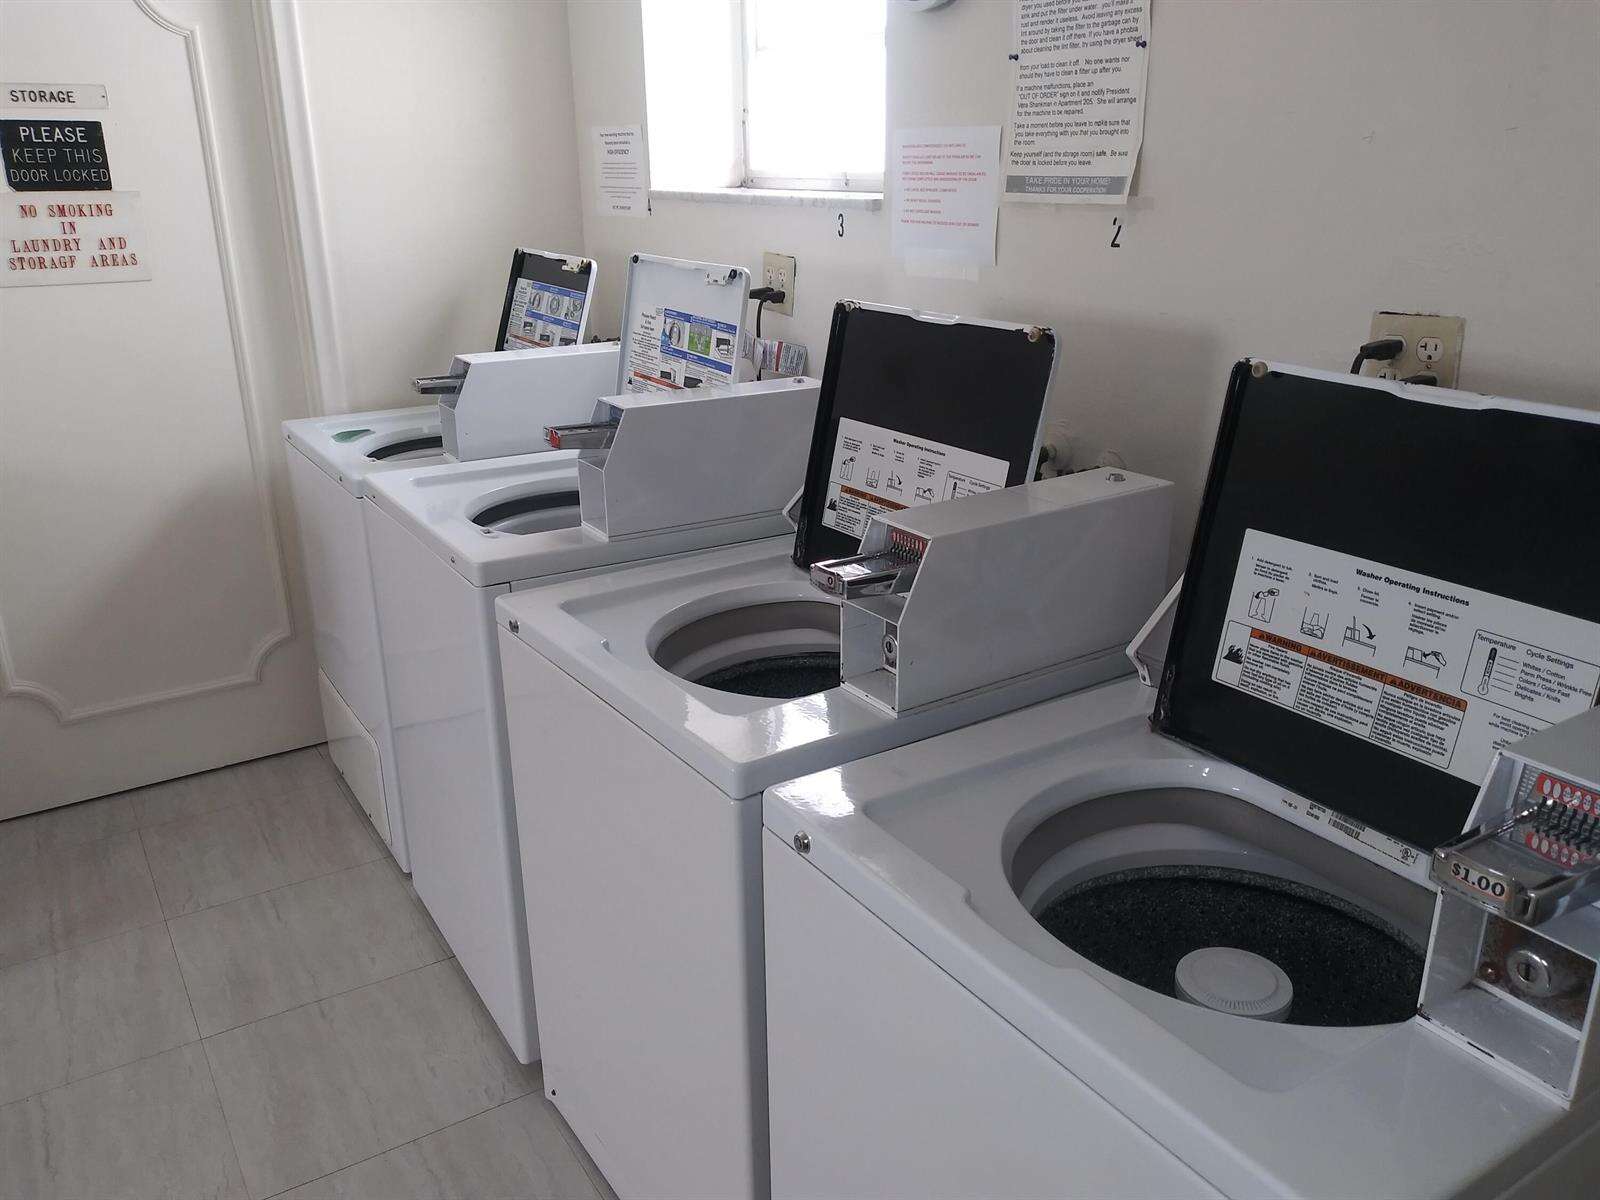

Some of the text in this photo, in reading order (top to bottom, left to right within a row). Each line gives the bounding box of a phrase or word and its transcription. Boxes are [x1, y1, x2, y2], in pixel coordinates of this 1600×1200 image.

[1073, 81, 1086, 89] place
[1091, 88, 1105, 97] notify
[10, 90, 76, 104] STORAGE
[20, 126, 88, 143] PLEASE
[1099, 128, 1120, 136] brought
[12, 148, 103, 164] KEEP THIS
[1024, 150, 1042, 158] yourself
[1062, 150, 1080, 158] storage
[10, 169, 110, 182] DOOR LOCKED
[19, 204, 114, 218] NO SMOKING
[61, 222, 77, 235] IN
[838, 213, 845, 238] 3
[1110, 217, 1120, 248] 2
[10, 237, 128, 254] LAUNDRY AND
[91, 253, 138, 268] AREAS
[907, 442, 924, 451] Operating
[924, 446, 946, 457] Instructions
[1356, 568, 1470, 606] Washer Operating Instructions
[1265, 633, 1302, 652] WARNING
[1478, 634, 1517, 650] Temperature
[1317, 650, 1386, 682] AVERTISSEMENT
[1526, 648, 1574, 669] Cycle Settings
[1522, 662, 1542, 673] Whites
[1546, 670, 1566, 680] Cotton
[1518, 676, 1536, 688] Colors
[1541, 684, 1557, 694] Color
[1558, 689, 1570, 698] Fast
[1520, 669, 1536, 678] Perm
[1536, 674, 1552, 684] Press
[1556, 680, 1578, 692] Wrinkle
[1399, 681, 1461, 708] ADVERTENCIA
[1514, 692, 1534, 702] Brights
[1516, 684, 1541, 698] Delicates
[1546, 694, 1561, 704] Knits
[1452, 862, 1506, 897] $1.00
